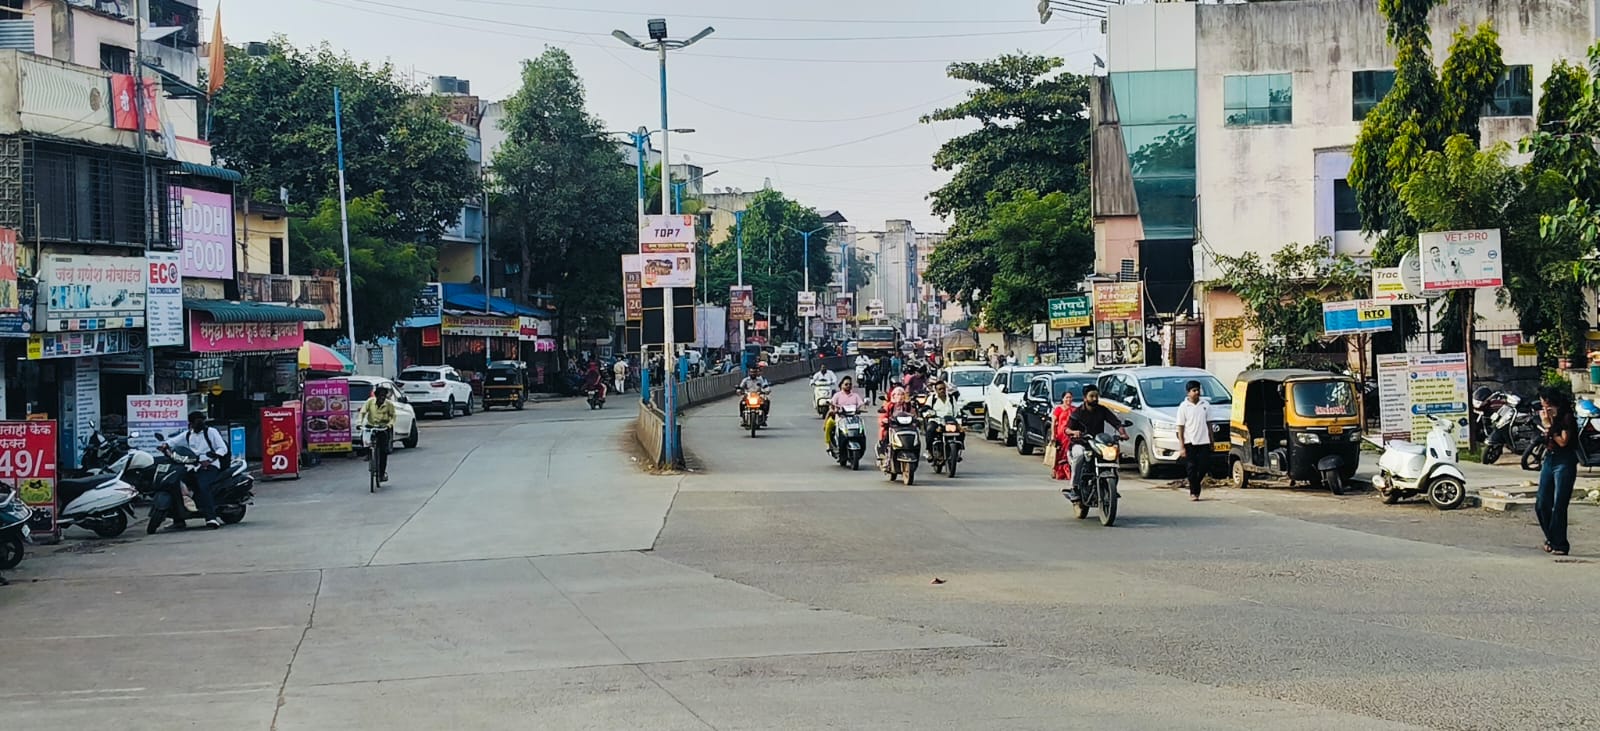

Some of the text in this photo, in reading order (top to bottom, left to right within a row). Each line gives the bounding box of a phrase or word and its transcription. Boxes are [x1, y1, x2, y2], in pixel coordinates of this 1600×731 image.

[171, 202, 229, 236] UDDHI
[1444, 232, 1489, 242] VET-PRO
[184, 239, 226, 273] FOOD
[55, 268, 75, 282] जय
[77, 263, 103, 283] गणेश
[1376, 271, 1399, 279] Trac
[1363, 309, 1385, 318] RTO
[130, 397, 184, 408] जय गणेश
[29, 422, 51, 434] केक
